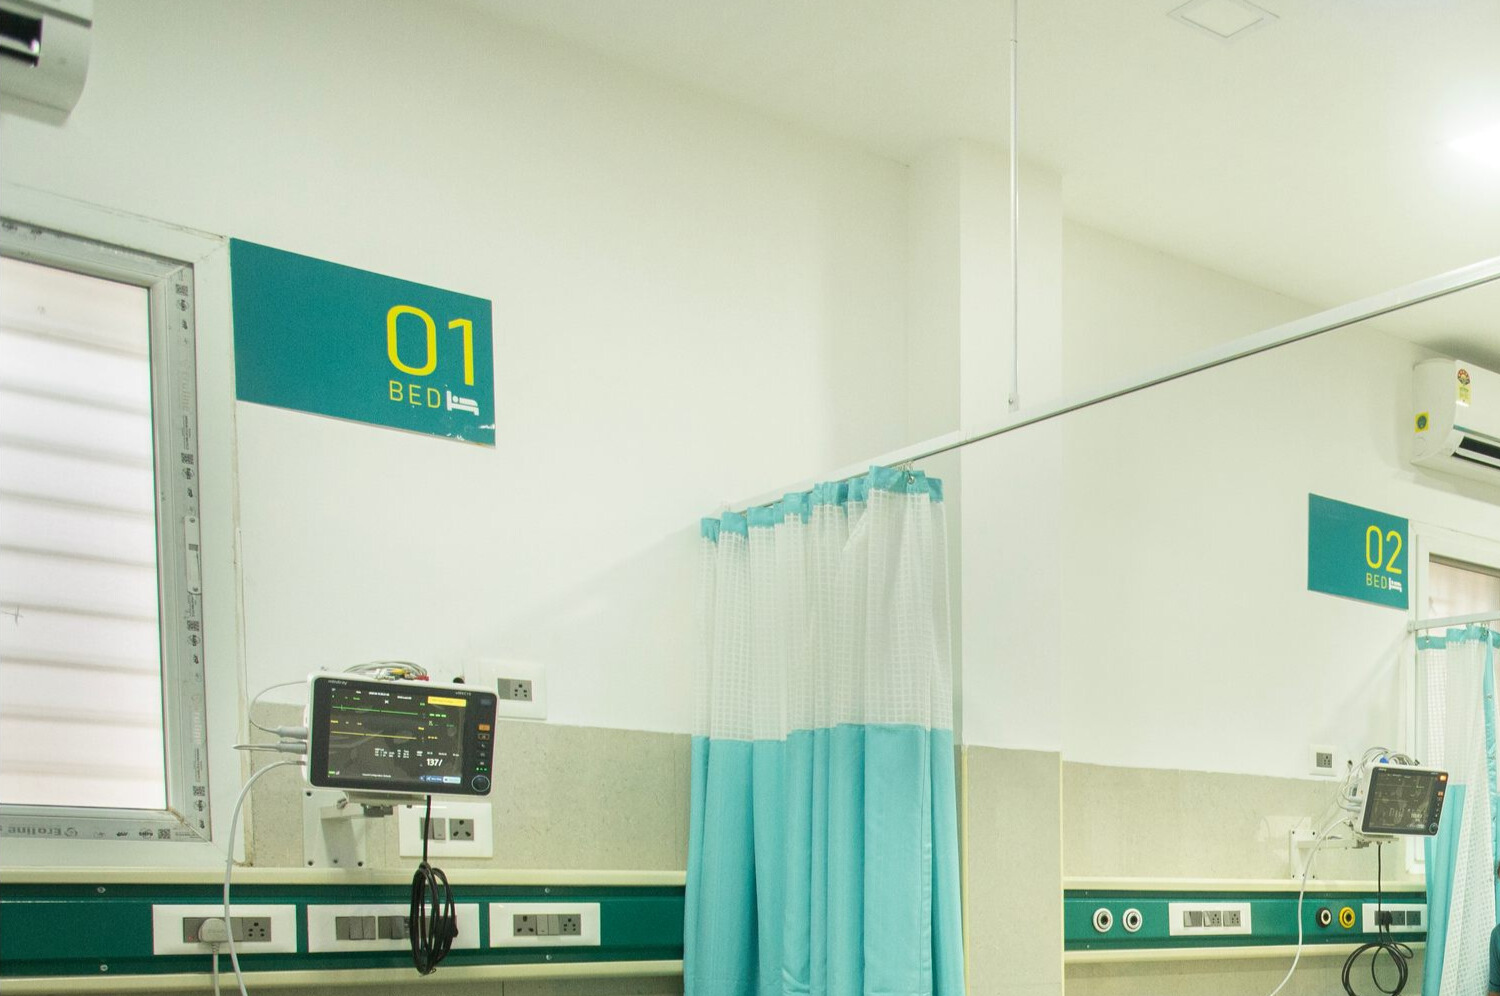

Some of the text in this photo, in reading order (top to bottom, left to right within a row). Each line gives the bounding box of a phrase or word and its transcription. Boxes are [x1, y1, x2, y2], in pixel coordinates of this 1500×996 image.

[386, 305, 475, 386] 01
[389, 380, 441, 408] BED
[1366, 525, 1402, 575] 02
[1366, 572, 1388, 589] BED
